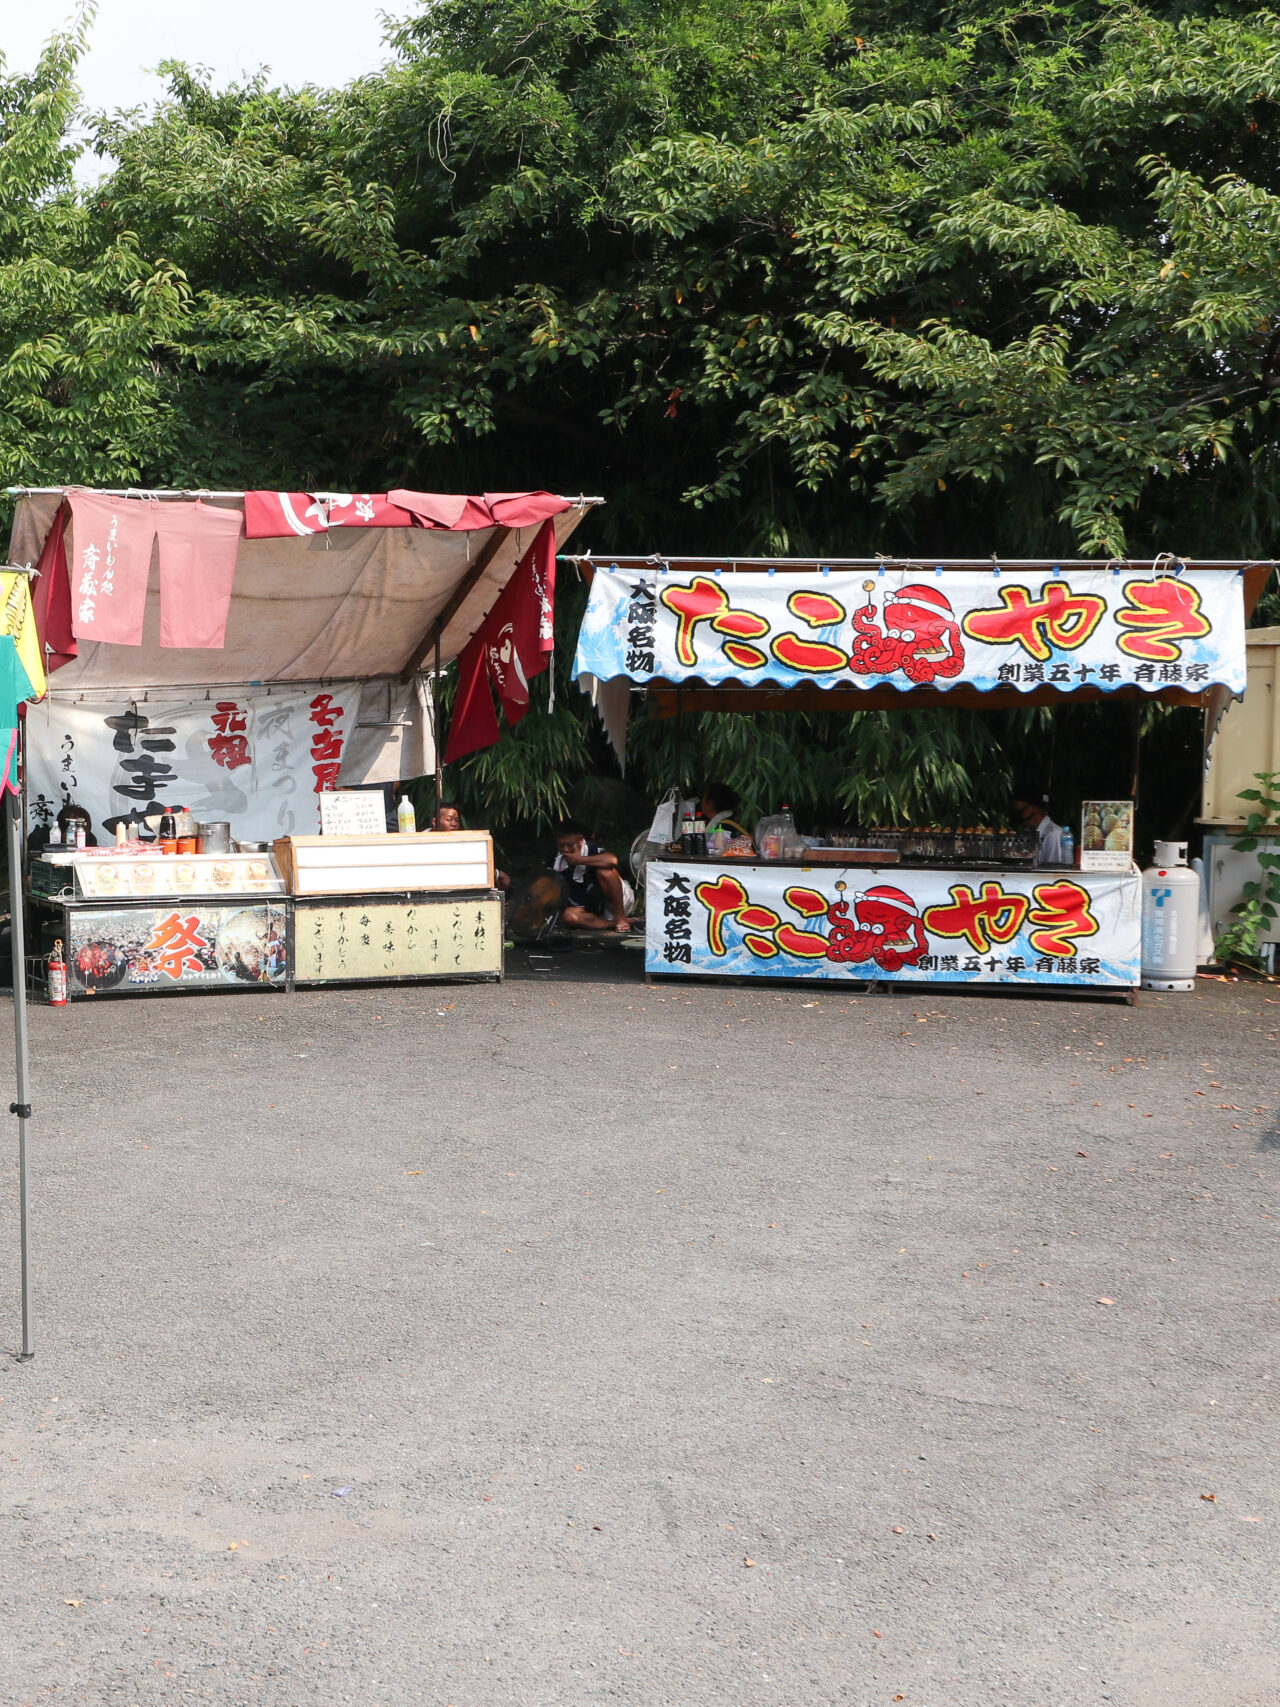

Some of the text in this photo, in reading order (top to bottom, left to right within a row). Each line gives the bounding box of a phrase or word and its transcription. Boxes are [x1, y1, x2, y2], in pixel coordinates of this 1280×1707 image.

[627, 578, 657, 673] 大阪名物
[662, 576, 1213, 671] たこ やき
[997, 662, 1122, 683] 創業五十年
[208, 702, 252, 770] 元祖
[310, 694, 344, 820] 名古屋
[143, 912, 208, 980] 祭
[662, 872, 694, 964] 大阪名物
[695, 874, 830, 957] たこ
[923, 880, 1098, 957] やき
[919, 955, 1026, 974] 創業五十年
